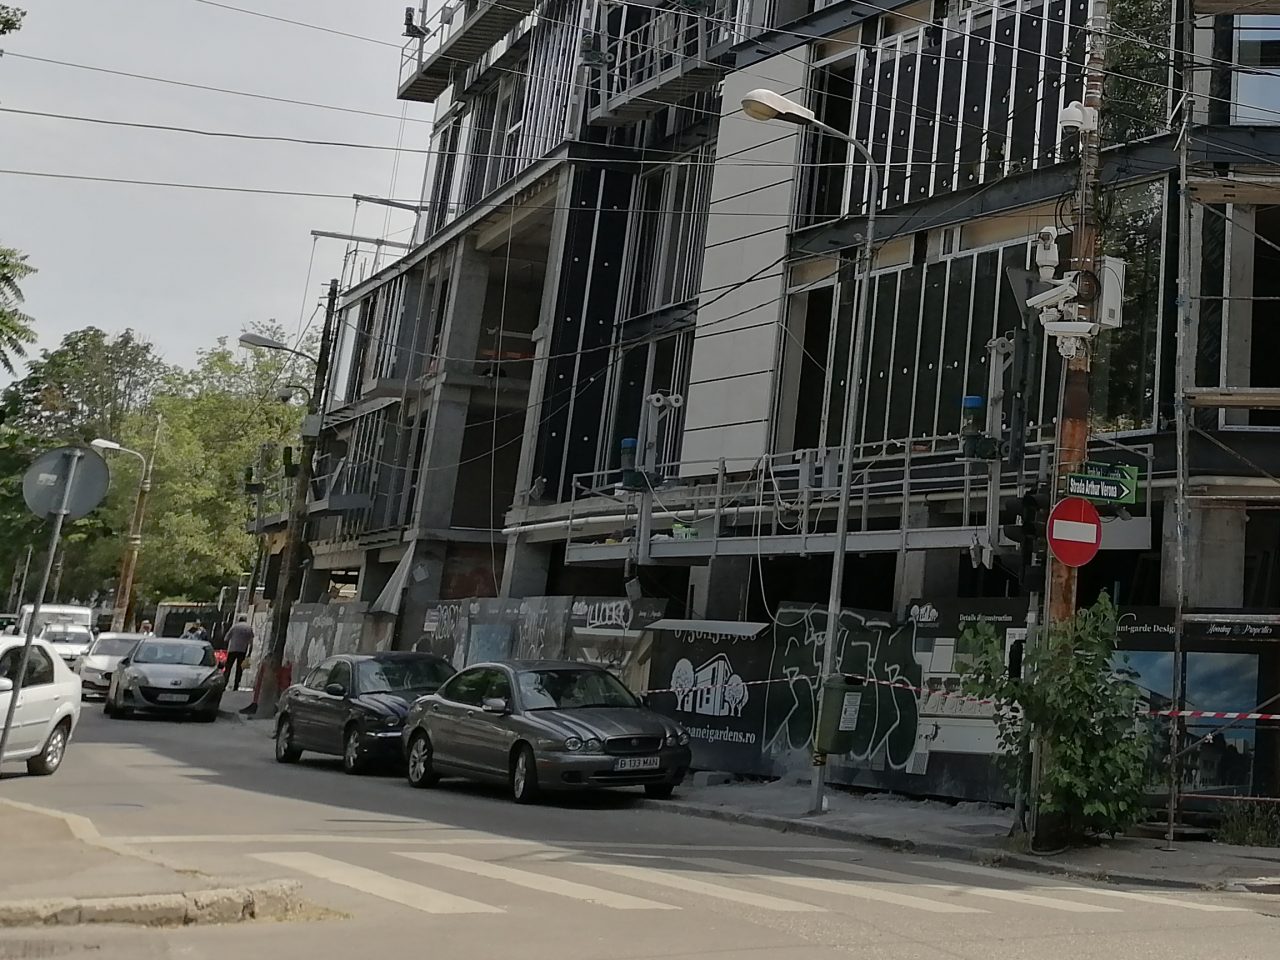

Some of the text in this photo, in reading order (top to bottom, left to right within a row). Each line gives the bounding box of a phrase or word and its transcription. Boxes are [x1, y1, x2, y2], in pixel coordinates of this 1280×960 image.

[1070, 478, 1117, 497] Strada Arthur Verona
[620, 759, 626, 769] B
